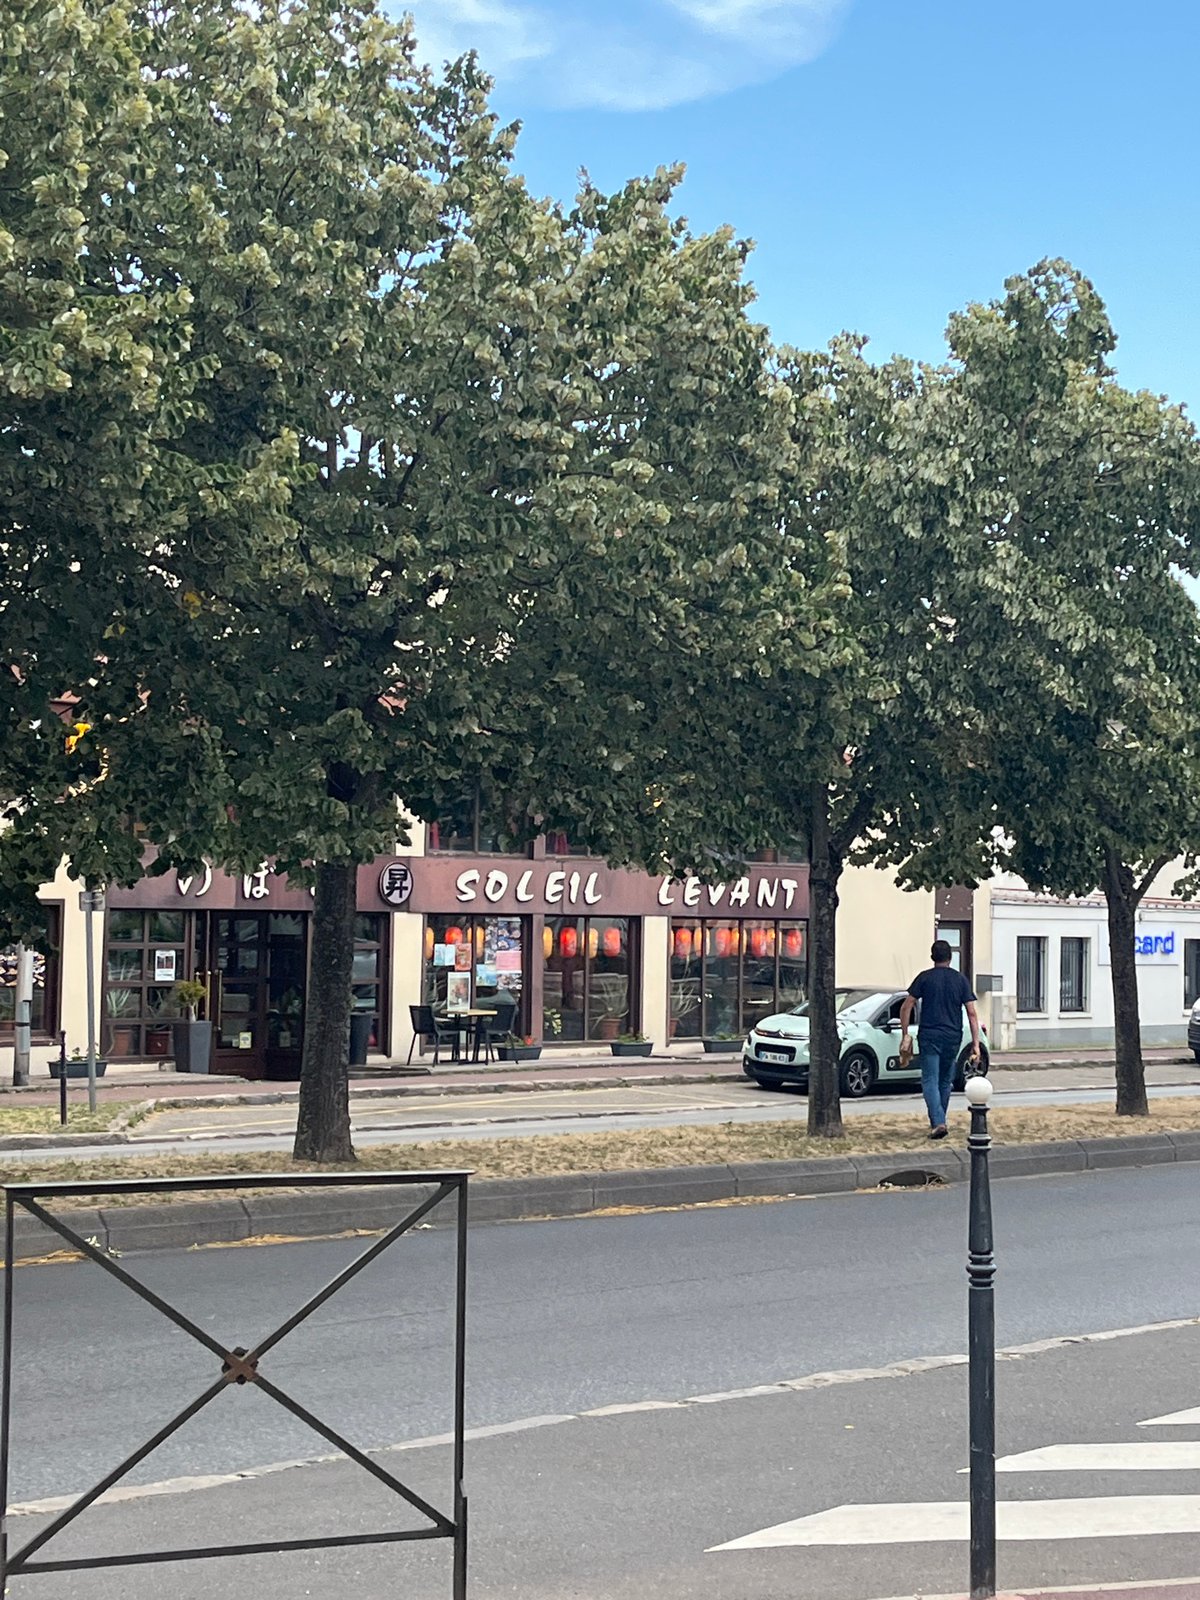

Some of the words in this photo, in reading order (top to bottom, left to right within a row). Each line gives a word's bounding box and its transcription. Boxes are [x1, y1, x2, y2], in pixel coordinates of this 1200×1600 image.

[456, 869, 602, 905] SOLEIL
[658, 875, 800, 910] LEVANT
[1134, 931, 1175, 955] card
